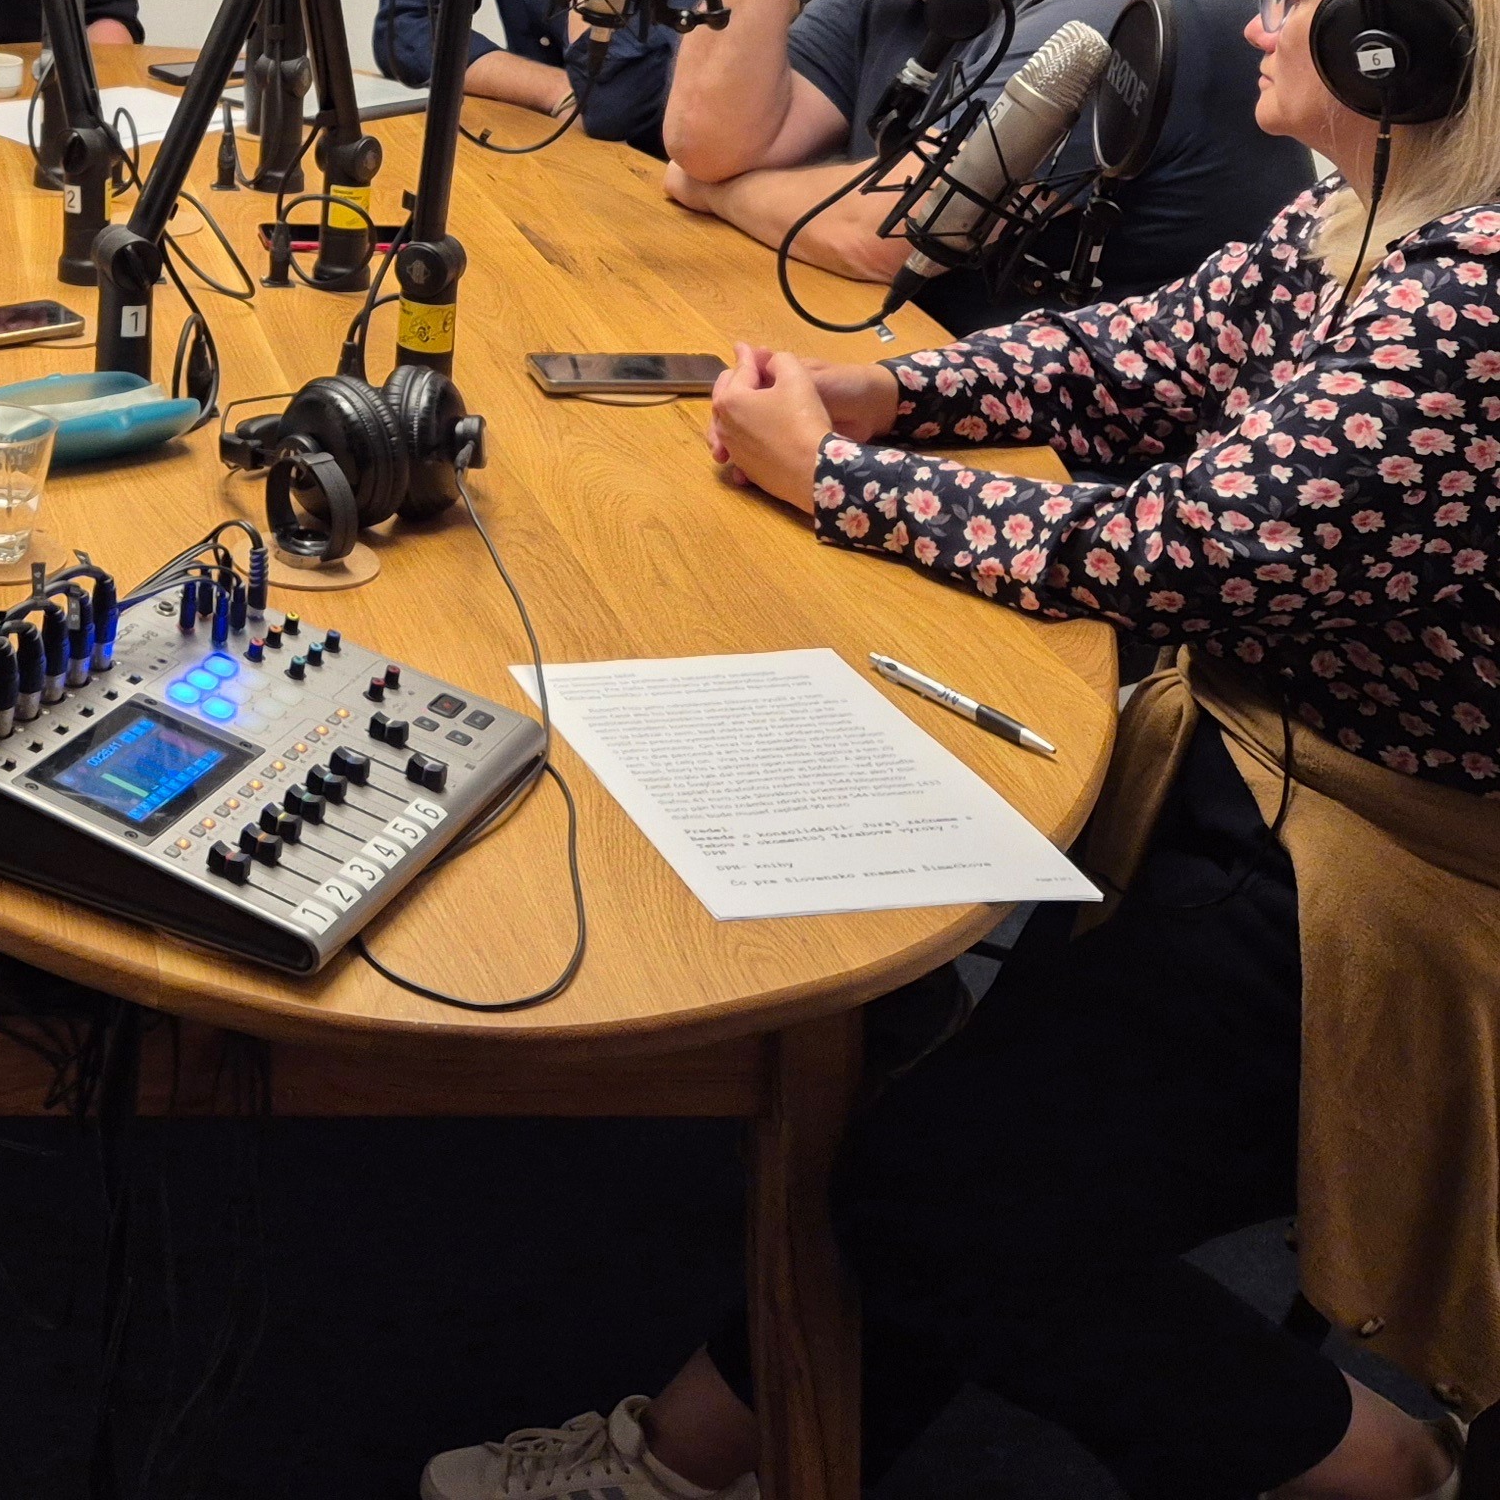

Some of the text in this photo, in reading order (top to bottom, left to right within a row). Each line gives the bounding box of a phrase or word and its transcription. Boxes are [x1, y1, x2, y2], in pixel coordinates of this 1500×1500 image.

[1372, 53, 1381, 67] 6
[990, 101, 1004, 121] 6
[66, 191, 76, 208] 2
[130, 311, 140, 332] 1
[415, 802, 440, 820] 6
[392, 822, 419, 840] 5
[374, 842, 398, 858] 4
[349, 863, 377, 882] 3
[325, 884, 354, 903] 2
[301, 906, 328, 923] 1
